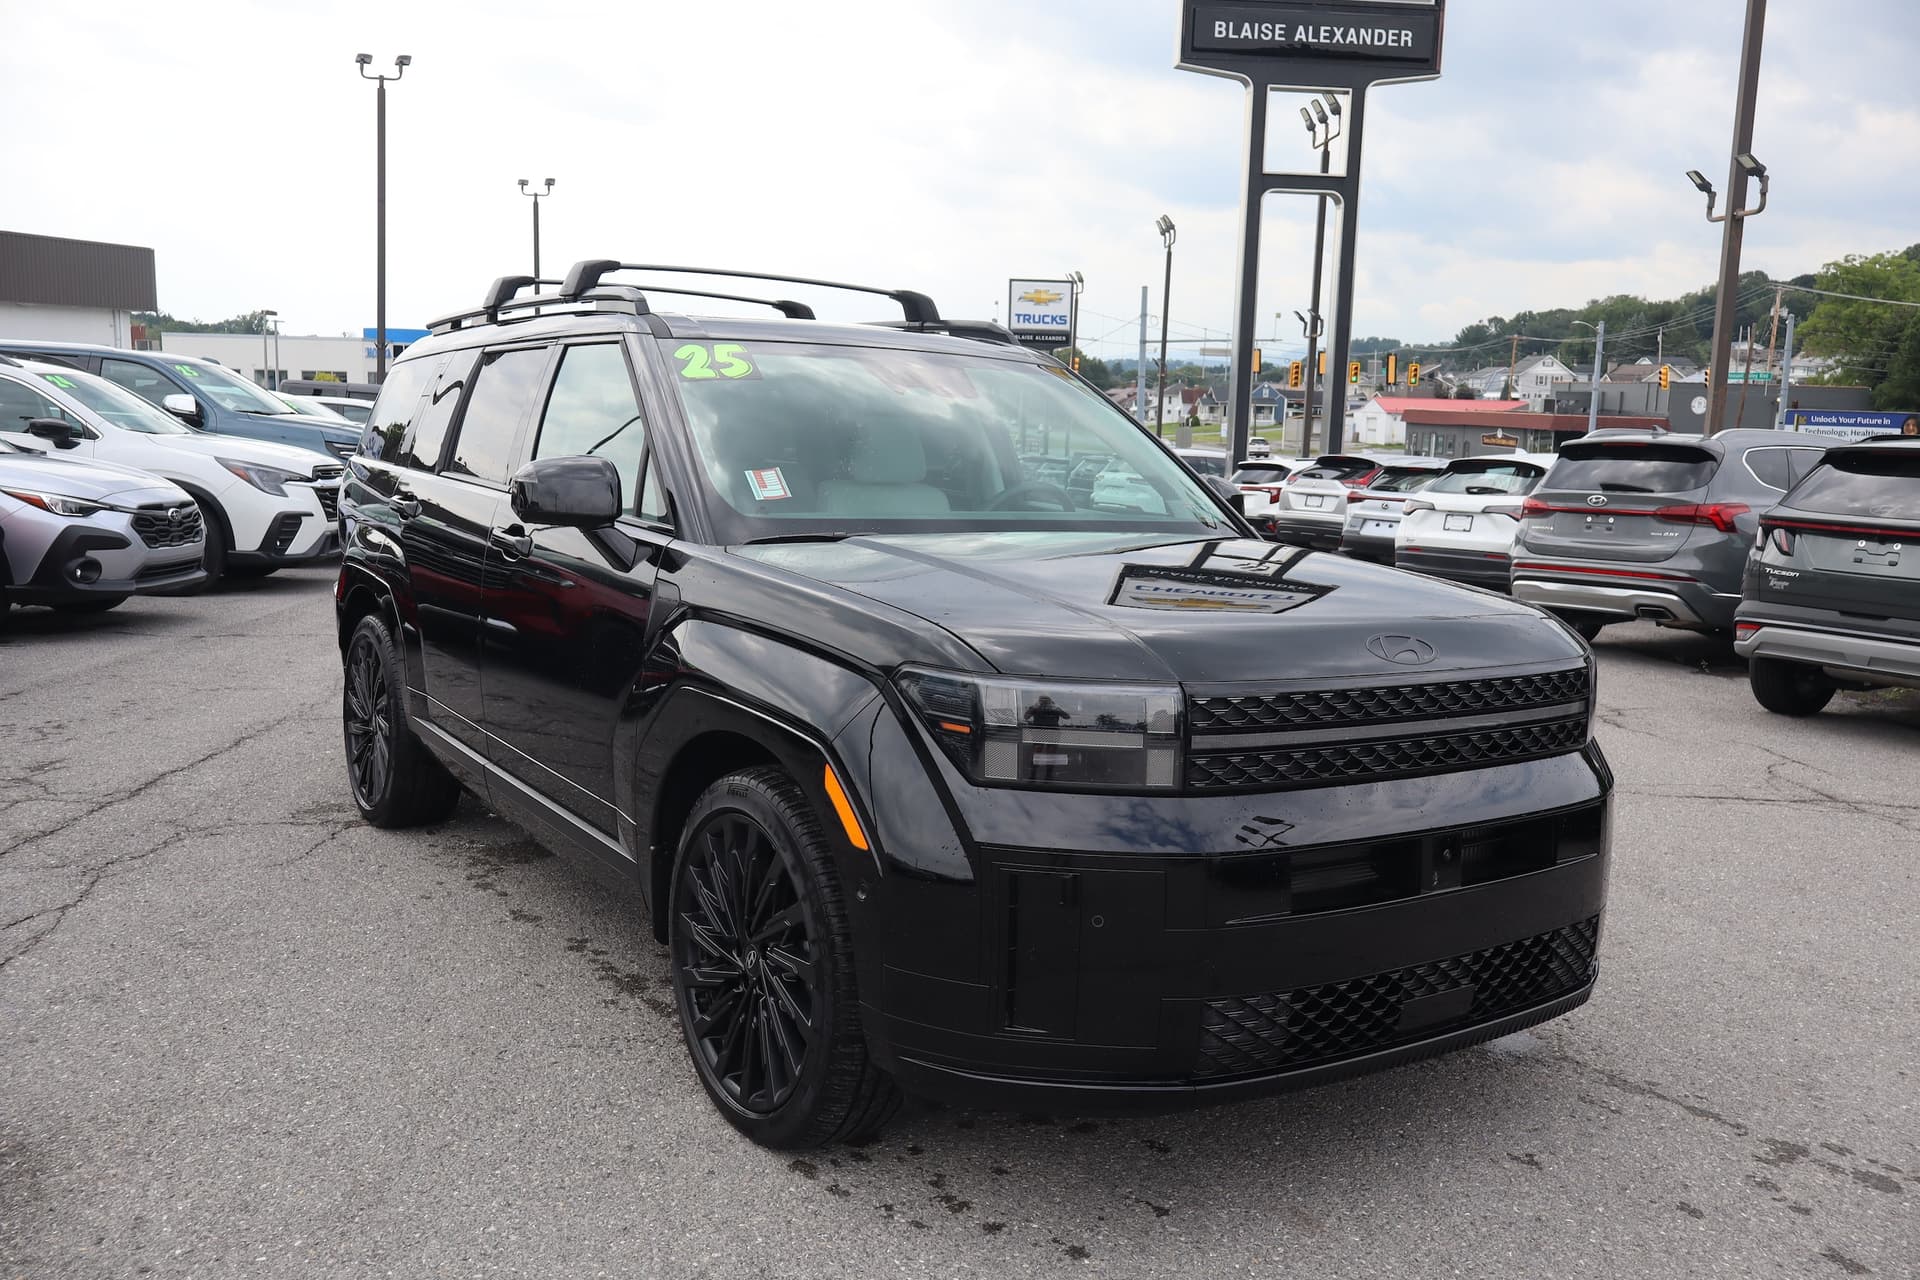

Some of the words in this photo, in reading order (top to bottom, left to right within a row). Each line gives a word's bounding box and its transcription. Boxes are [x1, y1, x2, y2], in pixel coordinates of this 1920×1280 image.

[1214, 20, 1287, 41] BLAISE
[1294, 23, 1413, 47] ALEXANDER
[1015, 313, 1067, 325] TRUCKS
[673, 344, 753, 379] 25
[175, 364, 199, 377] 25
[44, 375, 78, 389] 24
[1811, 415, 1838, 424] Unlock
[1838, 416, 1857, 425] Your
[1857, 416, 1883, 425] Future
[1805, 427, 1849, 438] Technology,
